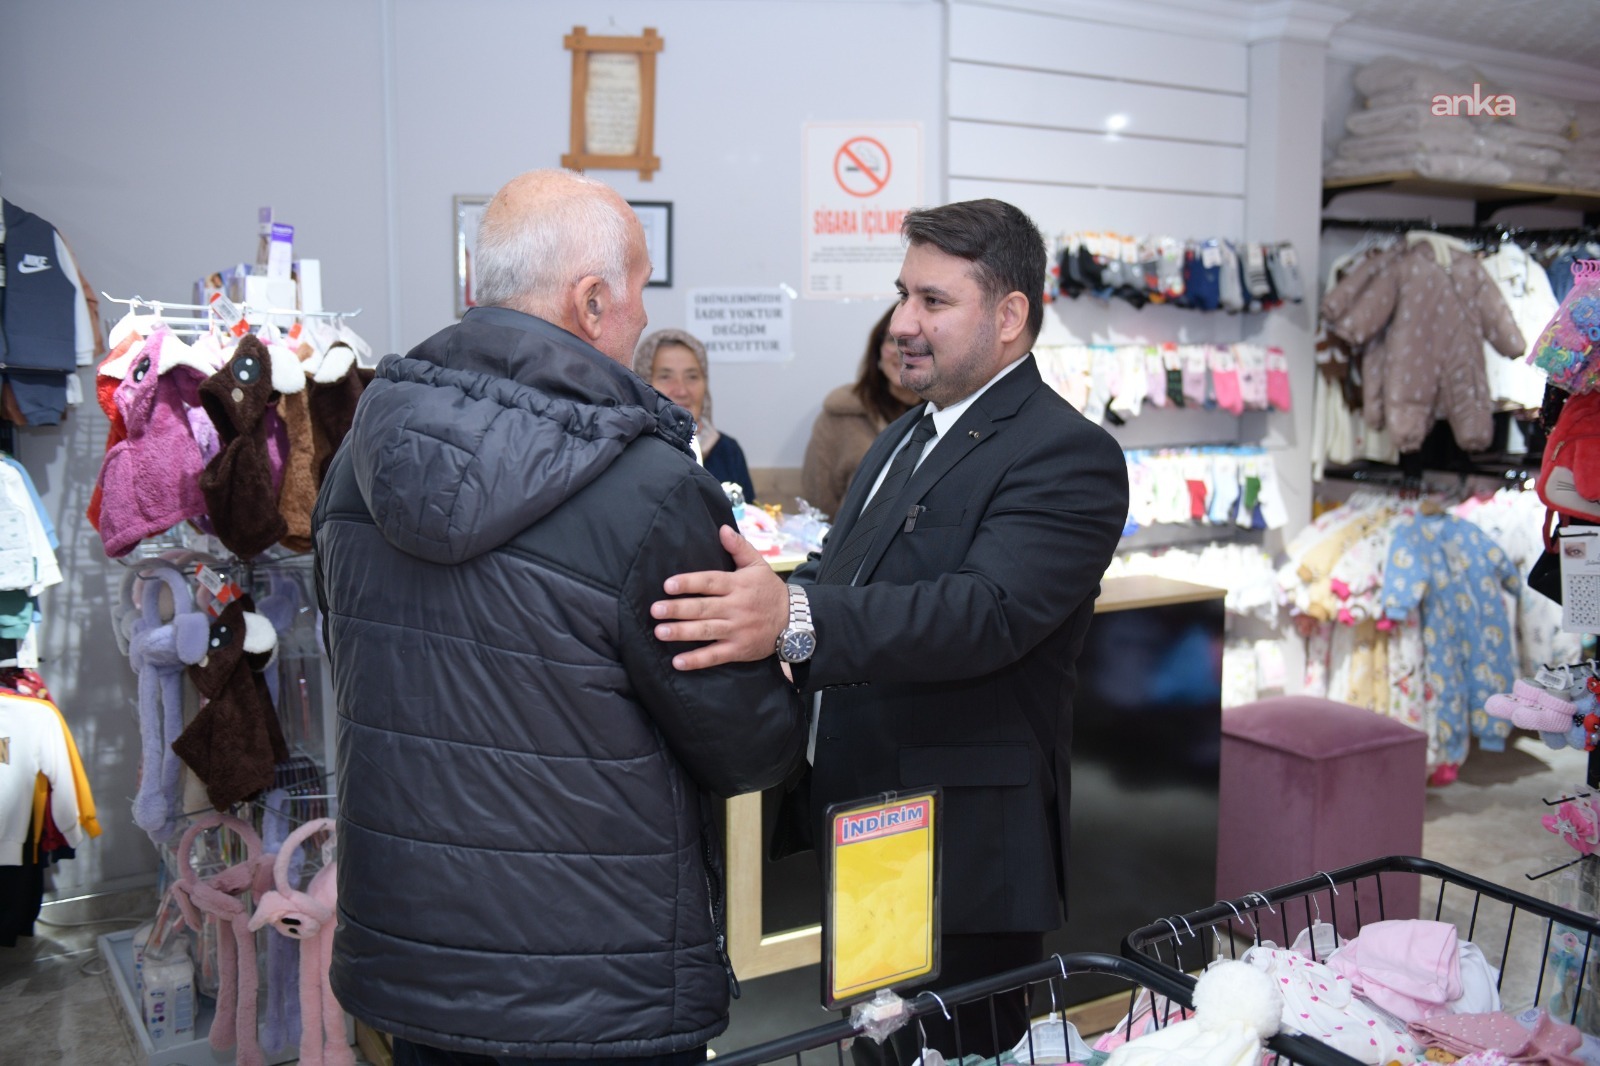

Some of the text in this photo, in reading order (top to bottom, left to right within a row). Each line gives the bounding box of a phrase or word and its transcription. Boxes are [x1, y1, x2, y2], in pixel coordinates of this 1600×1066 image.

[813, 205, 858, 235] SİGARA
[694, 307, 783, 320] İADE YOKTUR
[712, 324, 767, 337] DEĞİŞİM
[843, 806, 923, 840] İNDİRİM
